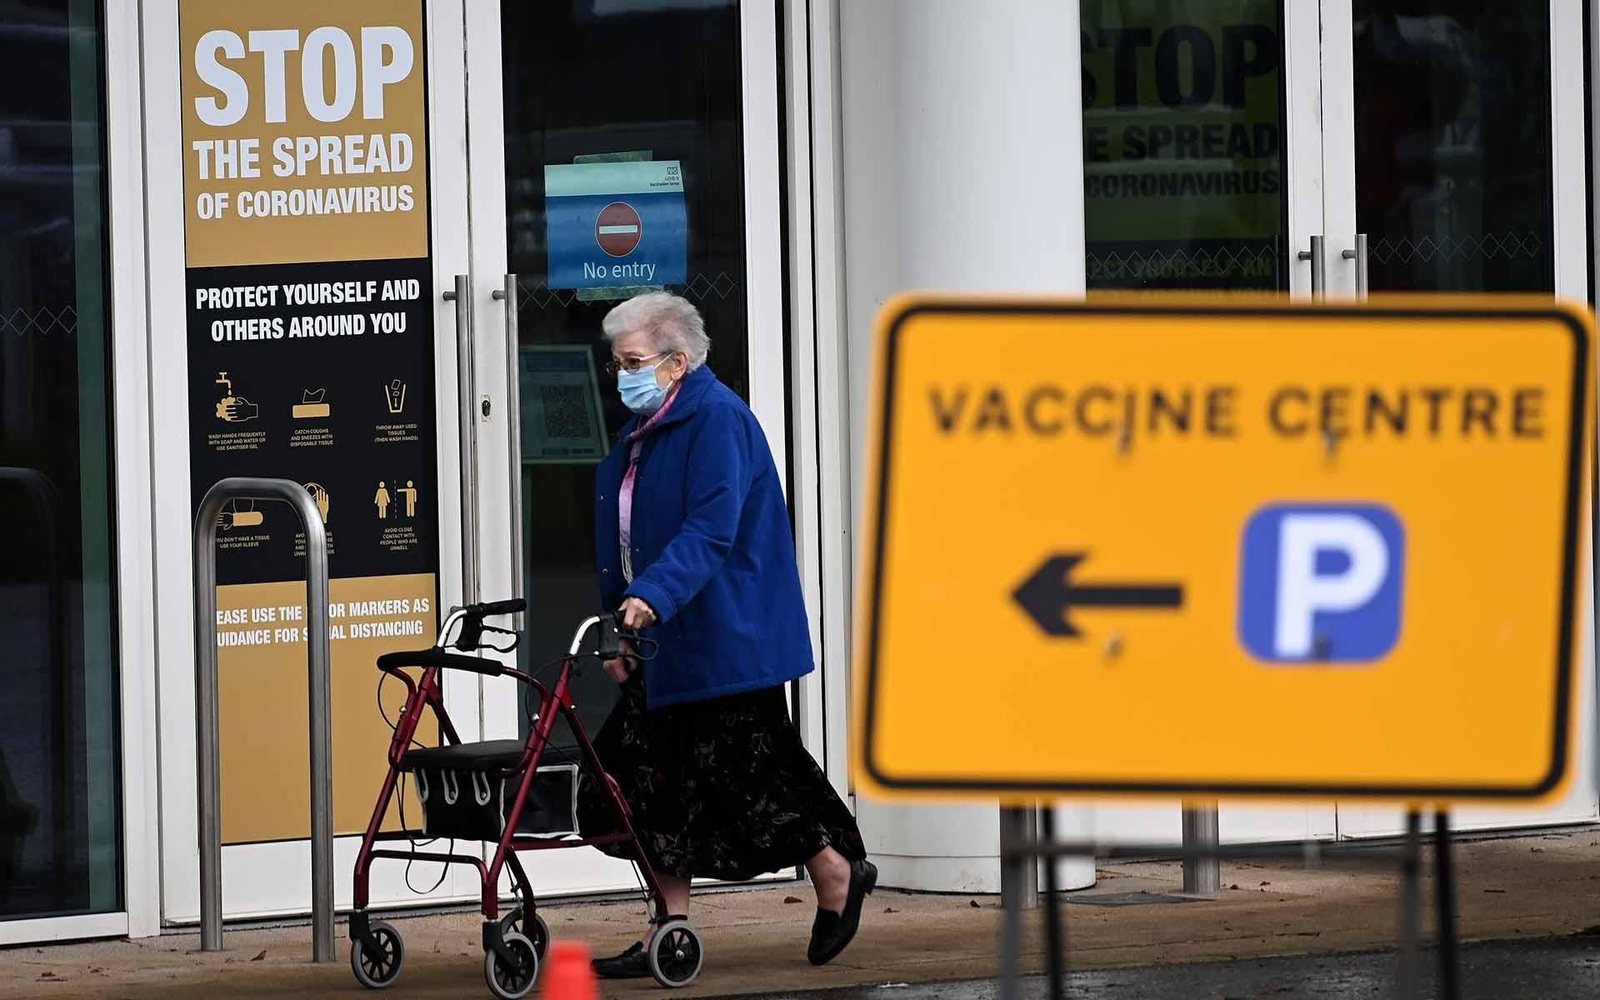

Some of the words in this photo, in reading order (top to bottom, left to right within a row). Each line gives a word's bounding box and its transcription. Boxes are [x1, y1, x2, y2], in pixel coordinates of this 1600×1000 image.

[194, 26, 414, 127] STOP
[192, 138, 261, 180] THE
[272, 133, 413, 178] SPREAD
[1123, 123, 1278, 160] SPREAD
[1085, 170, 1279, 197] CORONAVIRUS
[197, 192, 229, 220] OF
[237, 185, 414, 218] CORONAVIRUS
[583, 262, 607, 279] No
[612, 261, 656, 281] entry
[195, 285, 278, 310] PROTECT
[282, 280, 377, 306] YOURSELF
[381, 279, 420, 301] AND
[211, 317, 284, 342] OTHERS
[288, 313, 366, 339] AROUND
[369, 312, 407, 334] YOU
[928, 386, 1238, 440] VACCINE
[1268, 386, 1547, 440] CENTRE
[1276, 514, 1389, 657] P
[216, 610, 248, 625] EASE
[252, 606, 276, 622] USE
[279, 604, 302, 620] THE
[350, 599, 410, 616] MARKERS
[413, 598, 429, 612] AS
[216, 629, 271, 647] UIDANCE
[275, 629, 299, 643] FOR
[350, 619, 423, 638] DISTANCING
